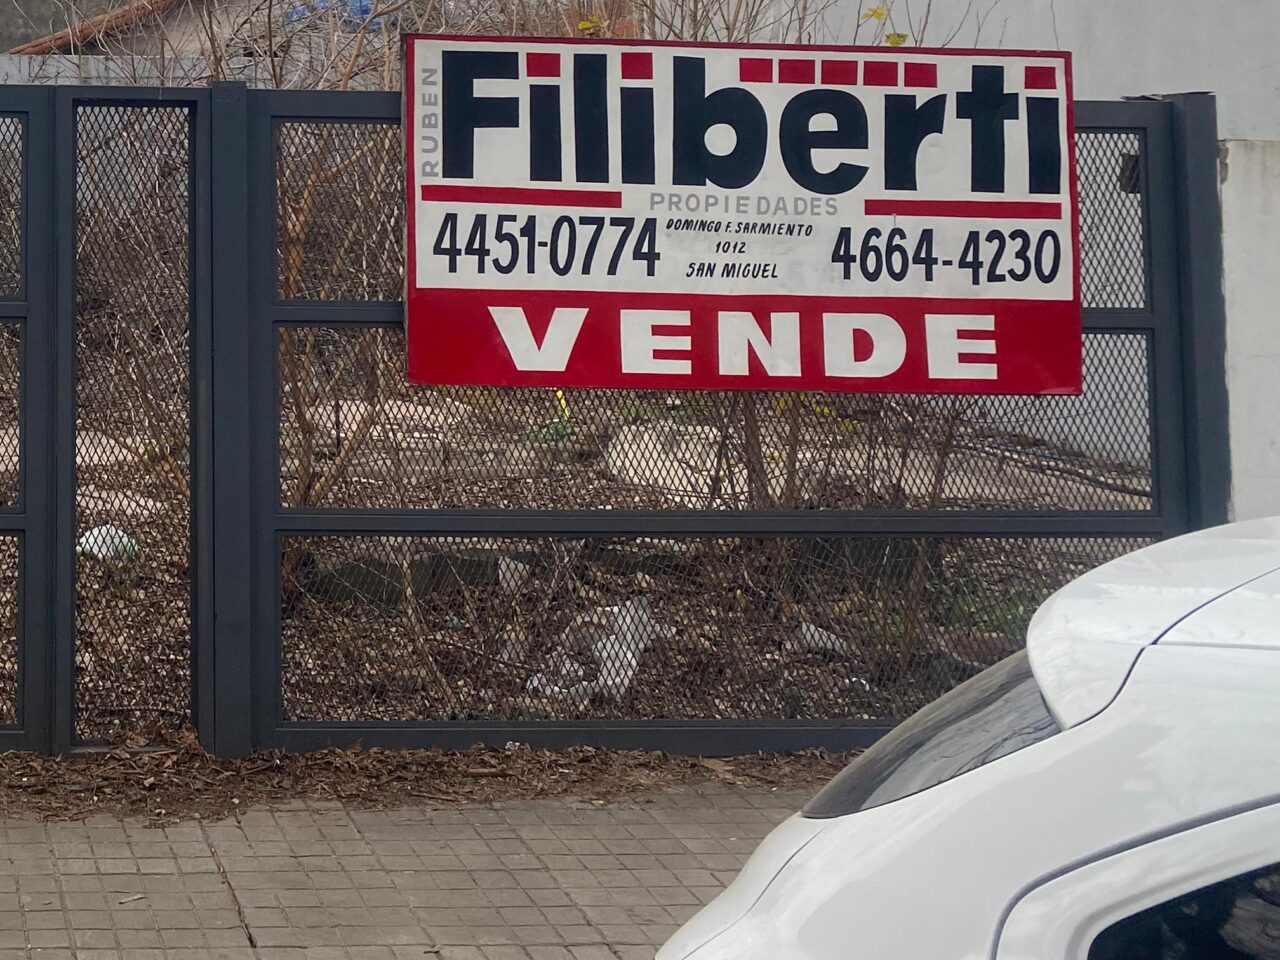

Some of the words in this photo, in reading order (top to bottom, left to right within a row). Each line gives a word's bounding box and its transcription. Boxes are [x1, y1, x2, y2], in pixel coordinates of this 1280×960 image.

[422, 66, 438, 179] RUBEN
[442, 50, 1062, 194] Filiberti
[650, 192, 838, 217] PROPIEDADES
[665, 218, 722, 233] DOMINGO
[734, 221, 813, 237] SARMIENTO
[433, 212, 661, 277] 4451-0774
[685, 262, 717, 278] SAN
[720, 262, 778, 278] MIGUEL
[715, 241, 747, 254] 1012
[831, 227, 1061, 285] 4664-4230
[487, 305, 998, 380] VENDE
